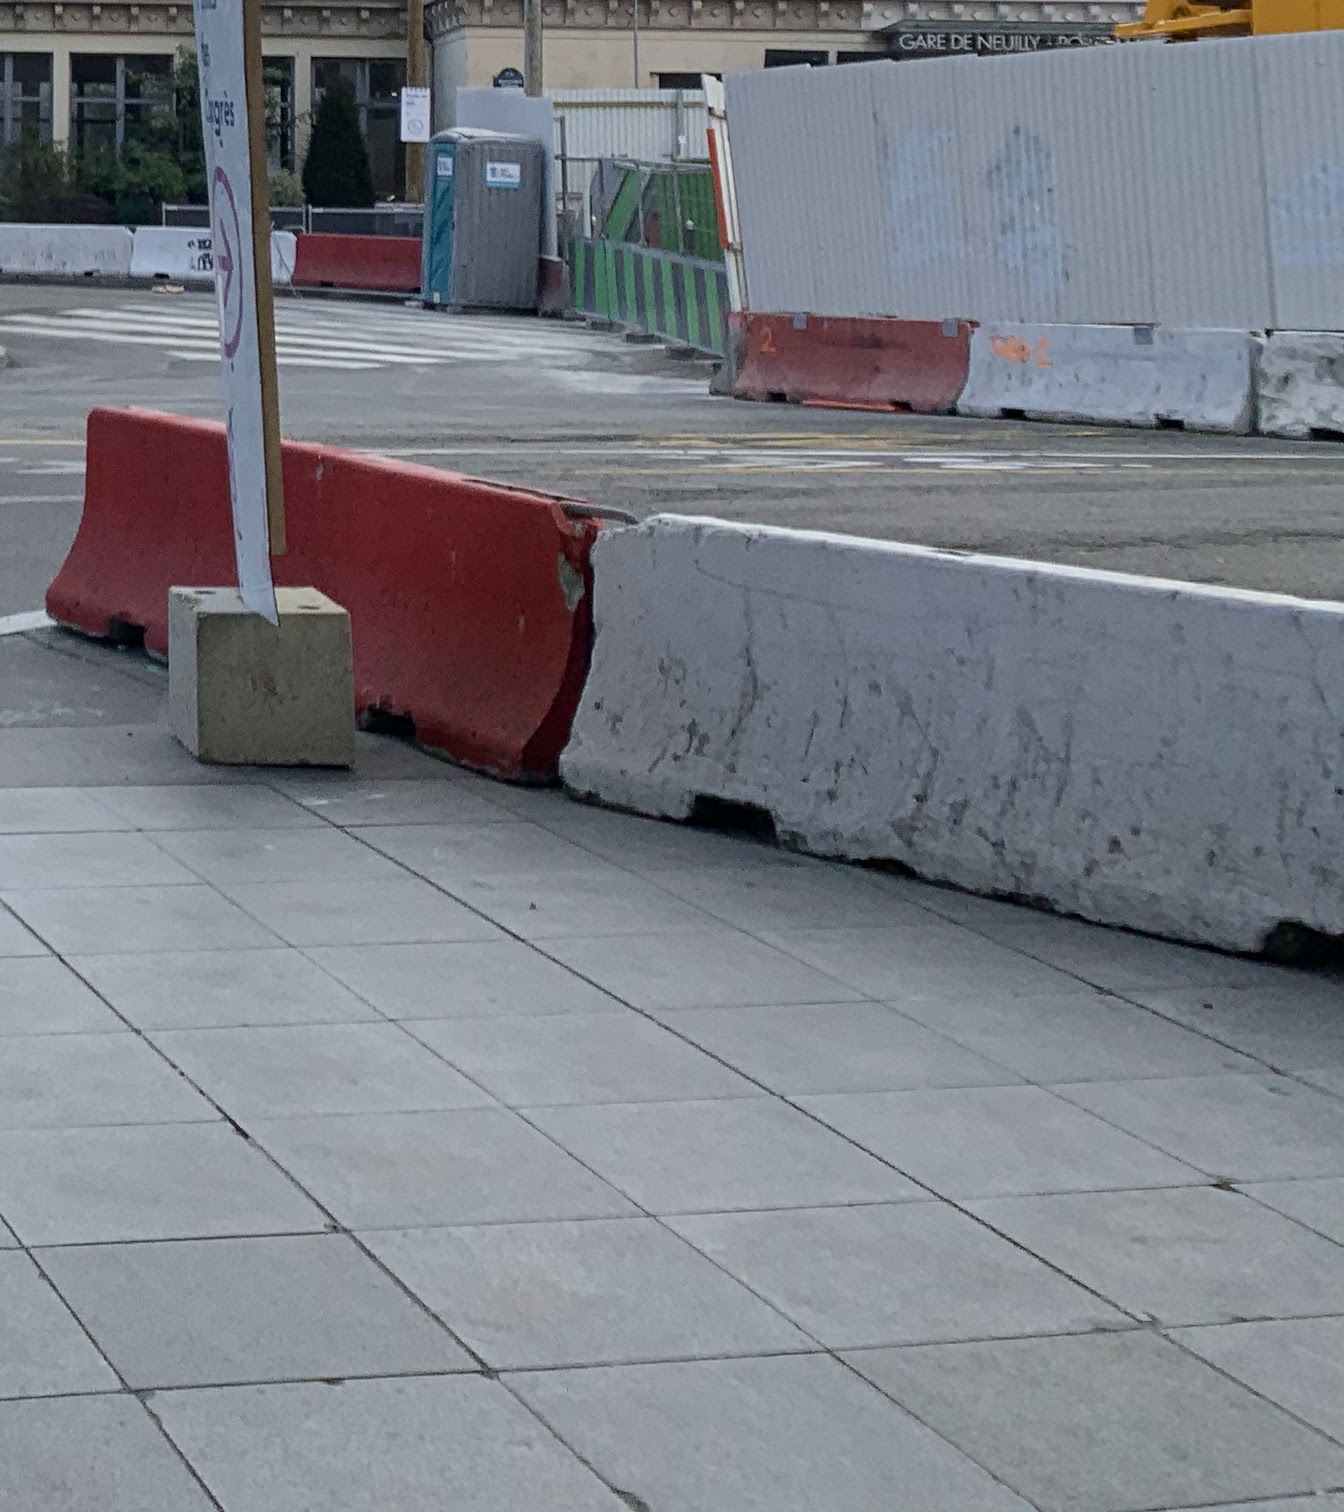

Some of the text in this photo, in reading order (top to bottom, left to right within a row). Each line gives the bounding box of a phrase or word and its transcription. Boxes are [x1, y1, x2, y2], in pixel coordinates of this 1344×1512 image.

[899, 33, 946, 51] GARE
[950, 34, 972, 51] DE
[977, 34, 1040, 52] NEUILLY
